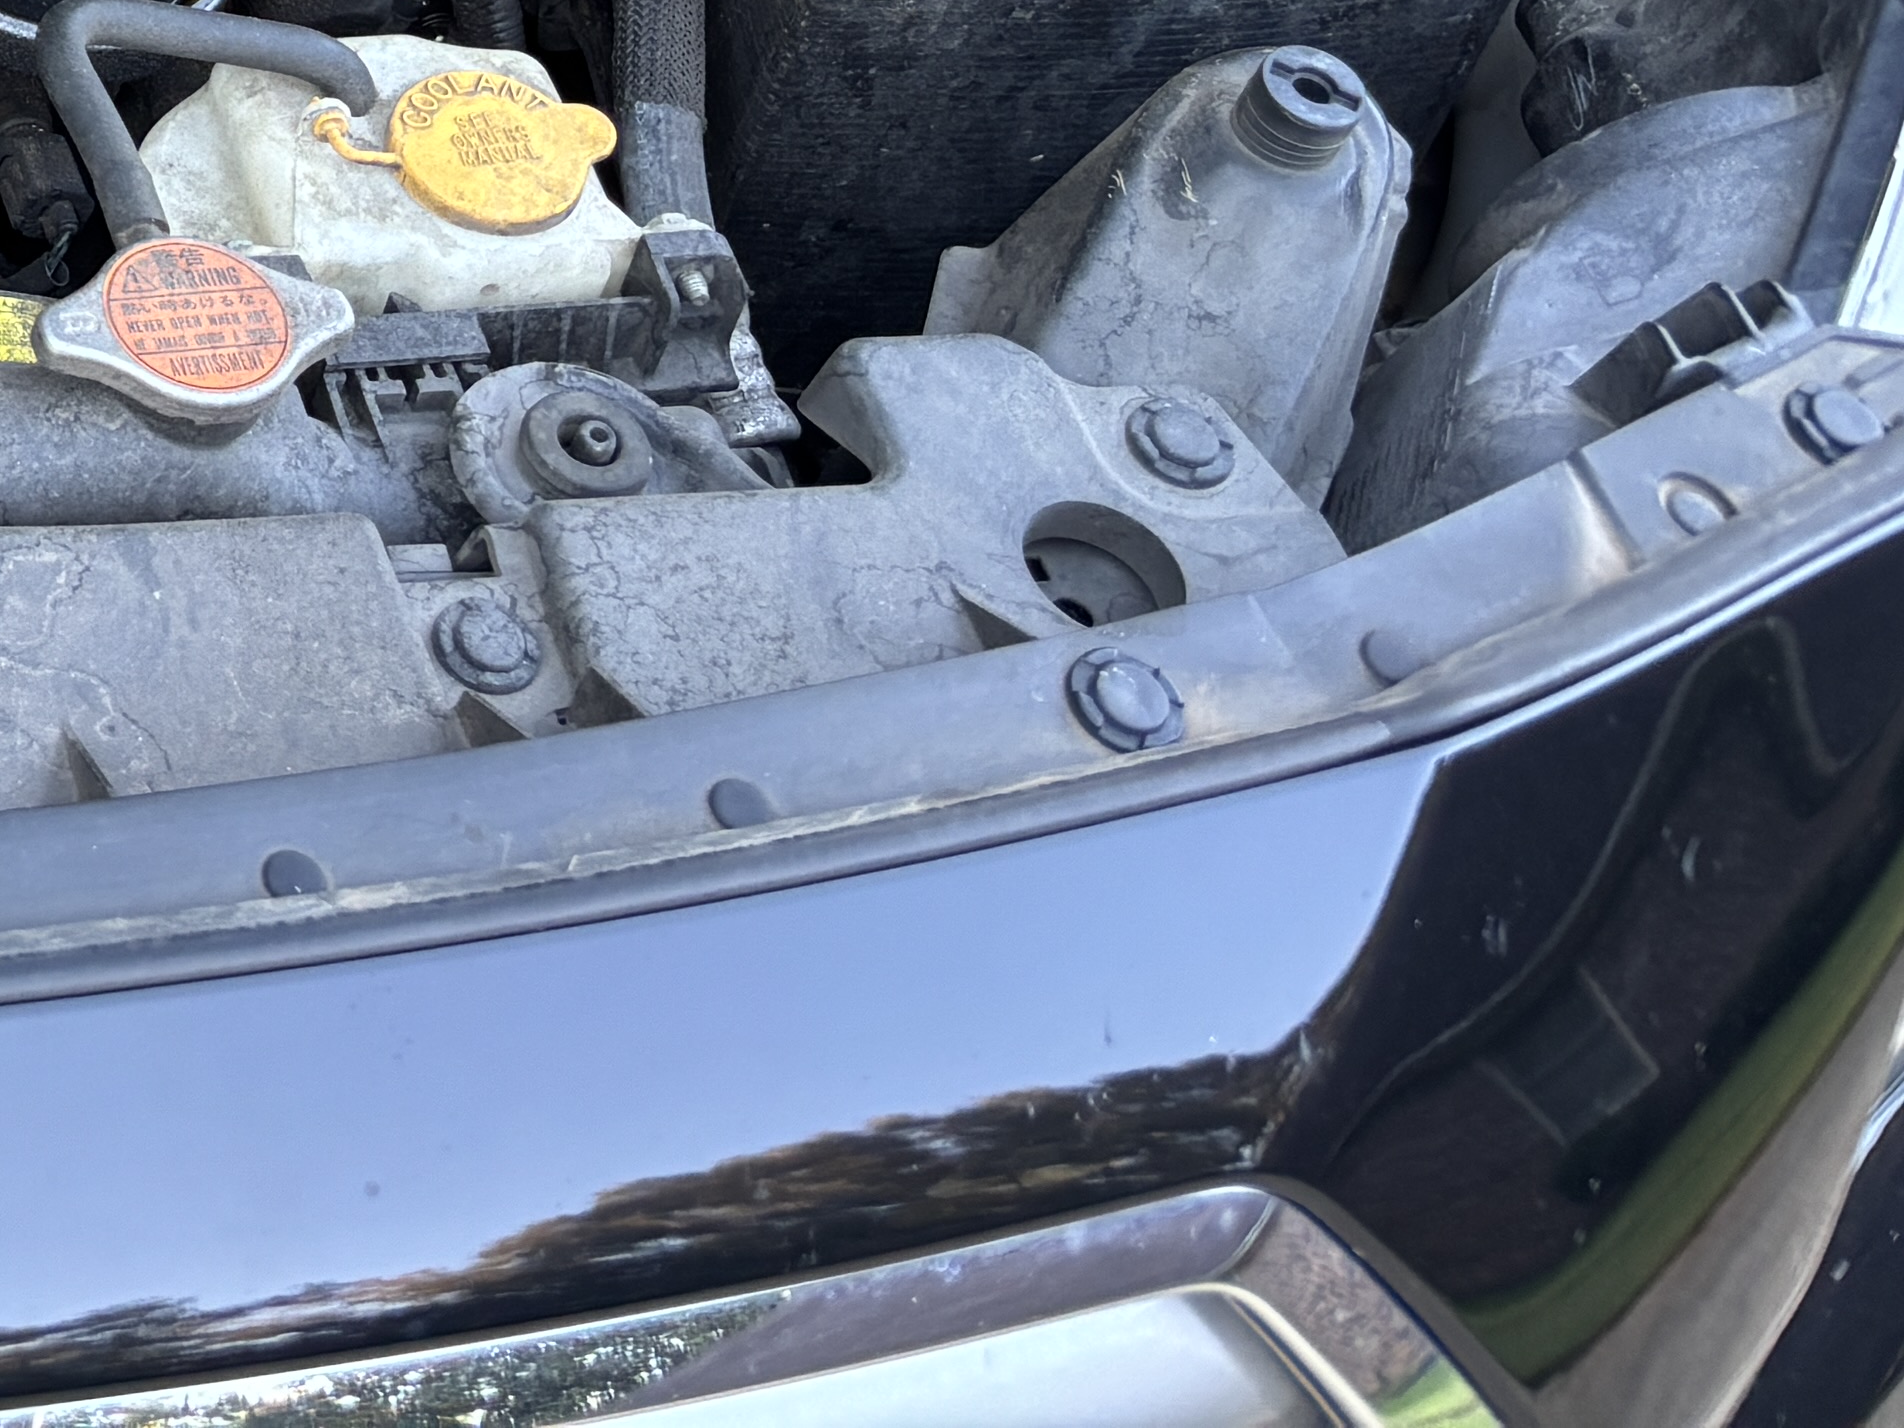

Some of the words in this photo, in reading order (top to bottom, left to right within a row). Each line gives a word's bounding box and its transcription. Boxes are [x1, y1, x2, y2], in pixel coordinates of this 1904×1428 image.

[402, 72, 550, 129] COOLANT
[455, 111, 494, 132] SEE
[458, 143, 542, 168] MANUAL
[159, 266, 241, 291] WARNING
[126, 319, 165, 334] NEVER
[170, 315, 202, 331] OPEN
[207, 311, 241, 327] WHEN
